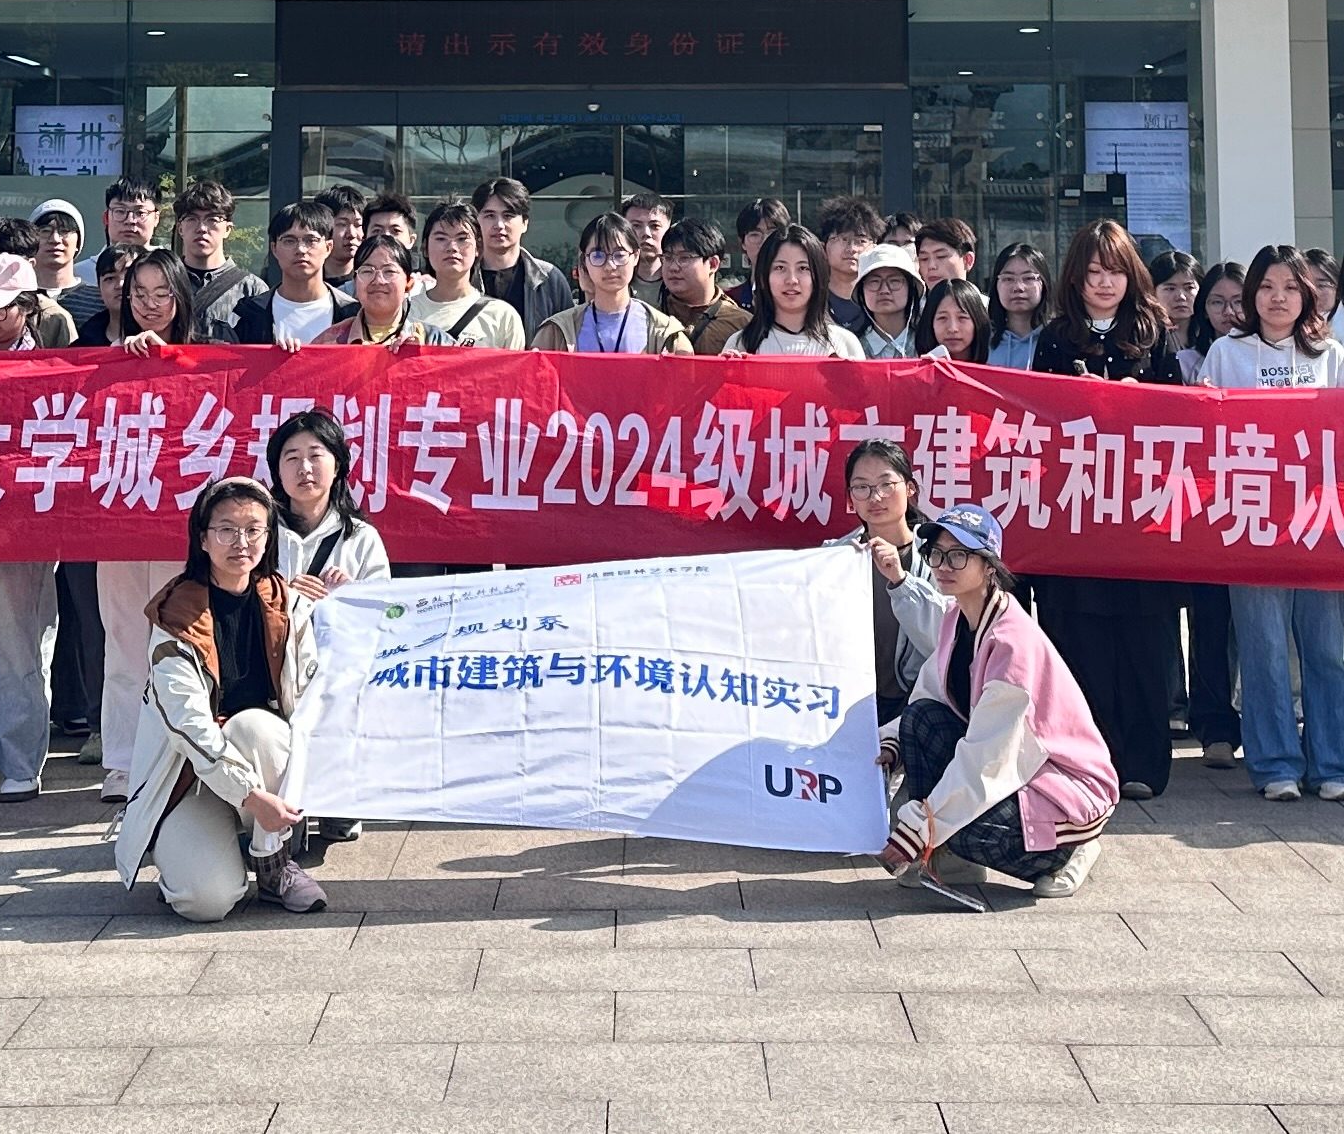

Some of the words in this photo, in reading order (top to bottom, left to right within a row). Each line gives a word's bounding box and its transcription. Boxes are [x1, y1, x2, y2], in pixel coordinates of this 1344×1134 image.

[397, 31, 791, 57] 请出示有效身份证件
[367, 652, 841, 719] 城市建筑与环境认知实习
[764, 764, 843, 804] URP
